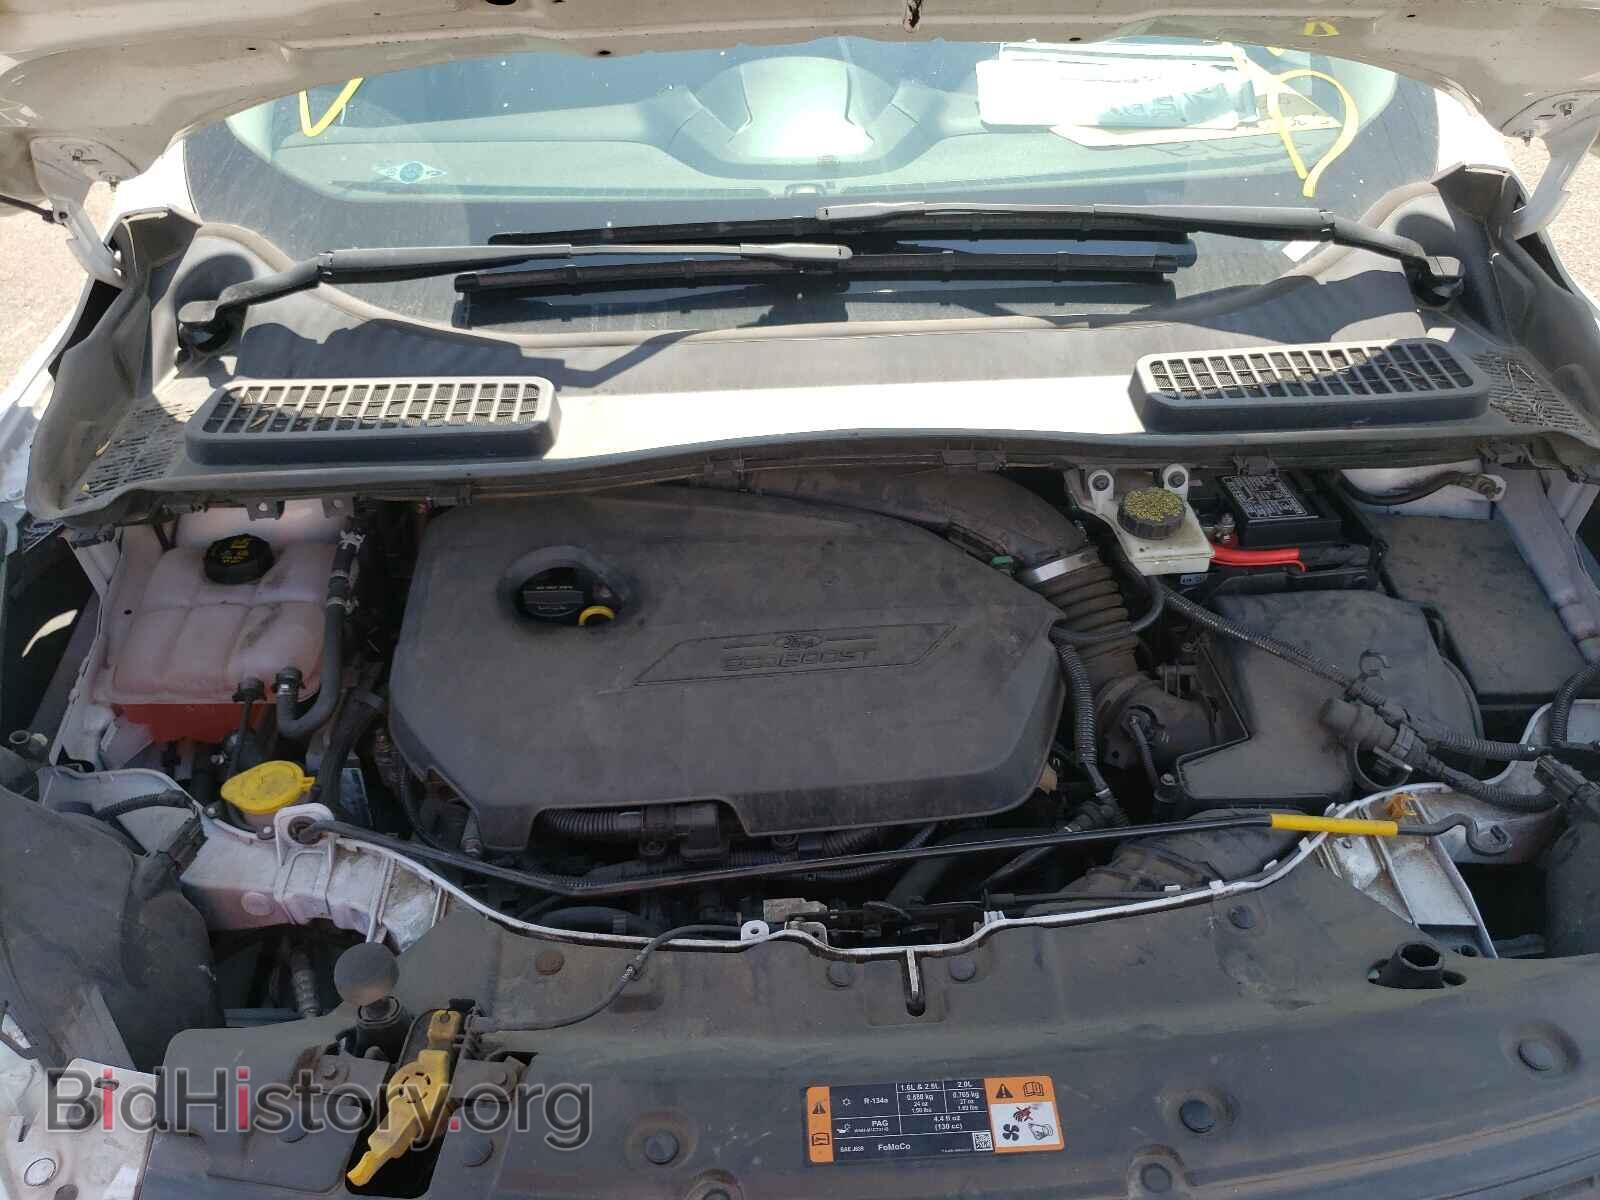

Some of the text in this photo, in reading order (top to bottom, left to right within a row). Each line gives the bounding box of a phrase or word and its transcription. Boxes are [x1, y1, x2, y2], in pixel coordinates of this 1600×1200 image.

[925, 1093, 934, 1102] kg
[871, 1119, 889, 1127] PAG
[877, 1142, 912, 1151] FoMoCo
